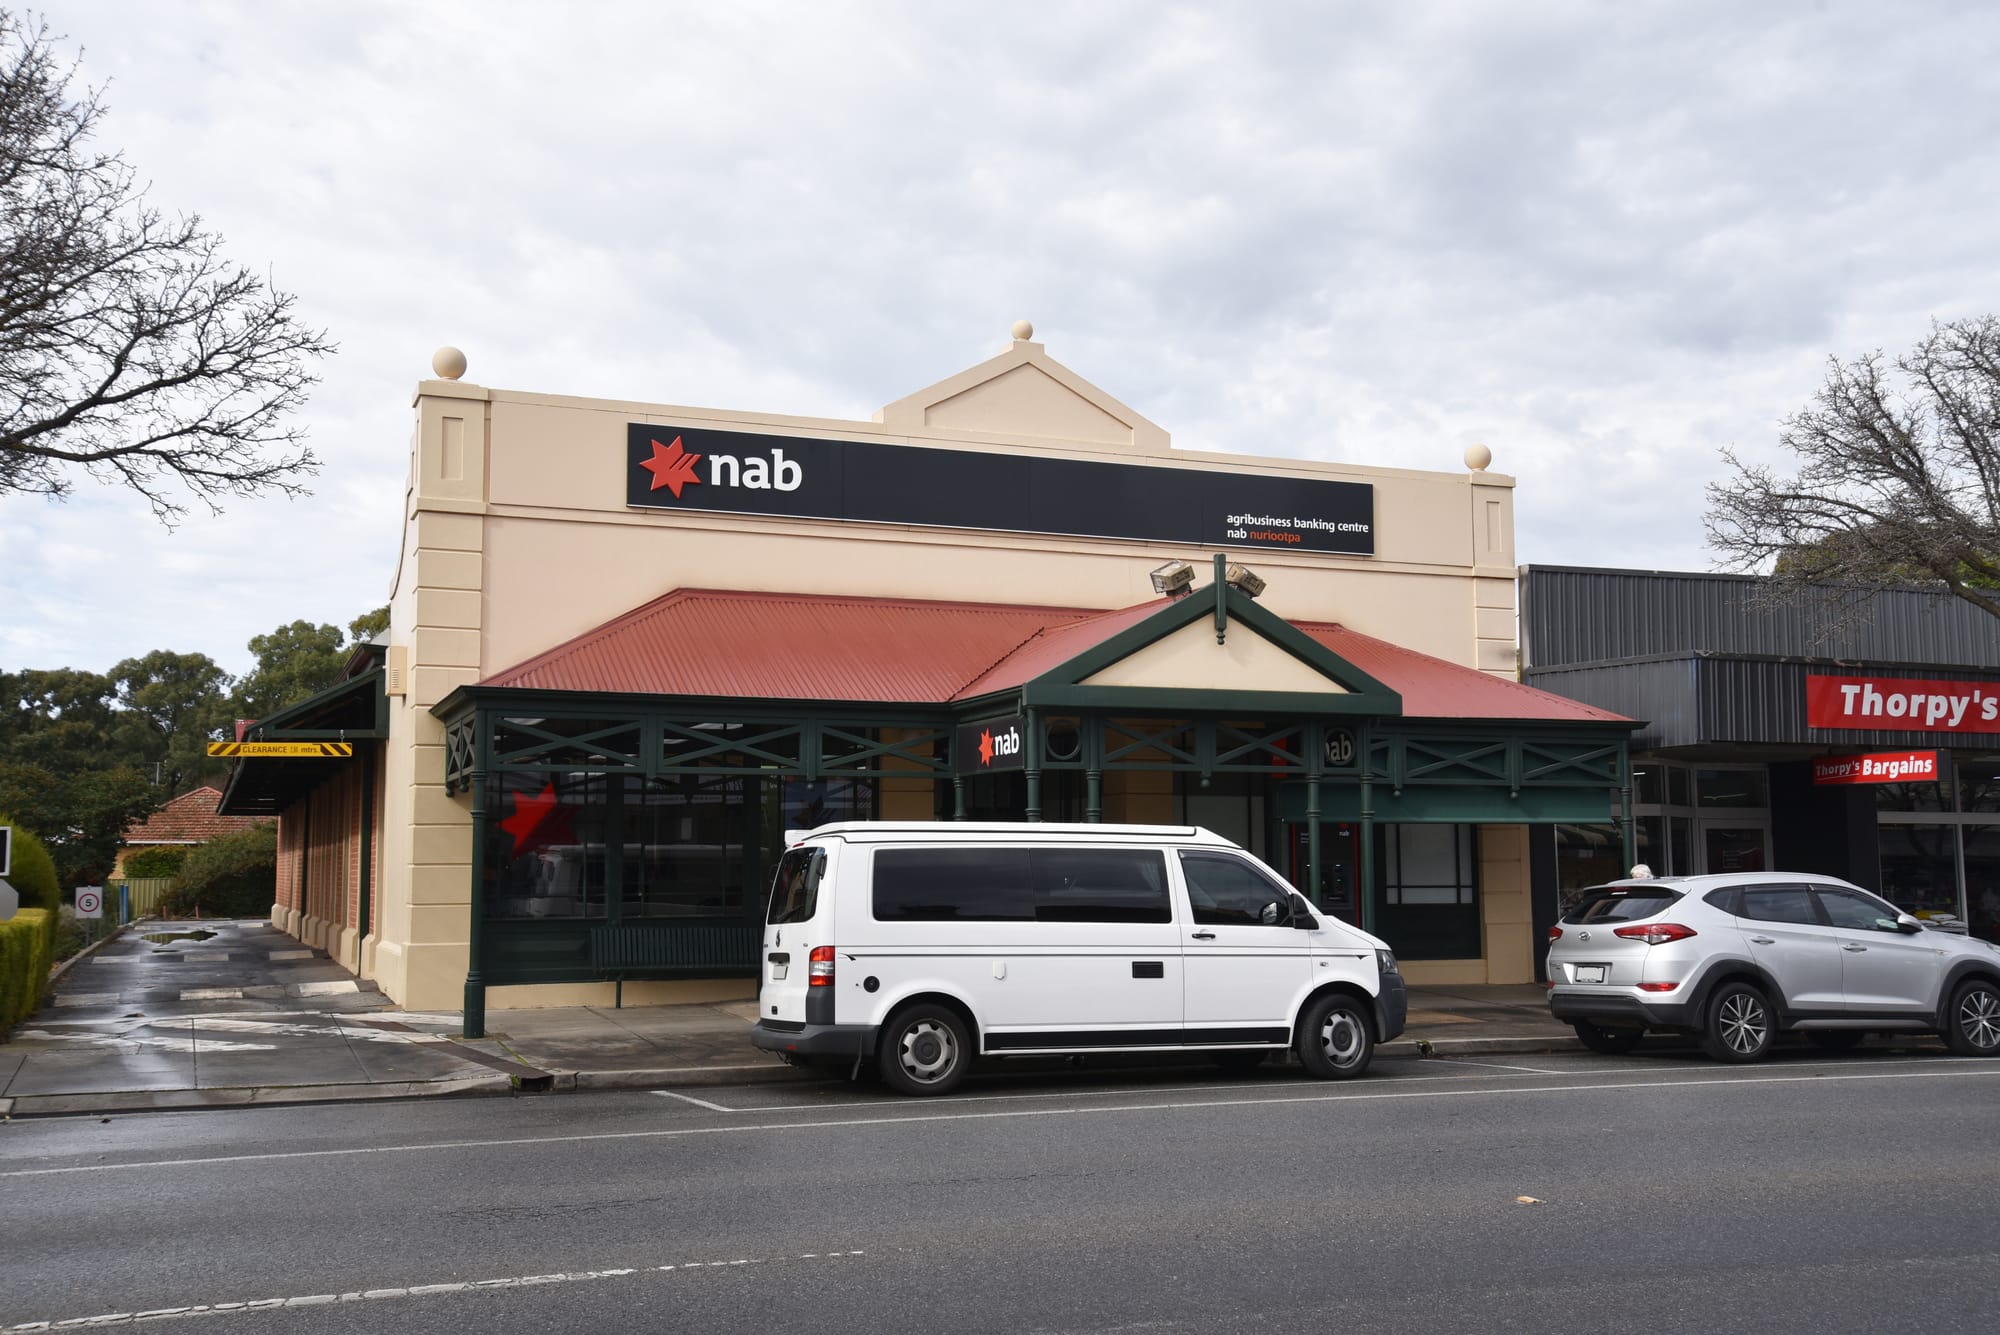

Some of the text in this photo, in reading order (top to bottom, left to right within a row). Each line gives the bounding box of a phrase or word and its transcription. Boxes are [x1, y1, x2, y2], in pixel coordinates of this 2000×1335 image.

[708, 448, 803, 492] nab
[1226, 513, 1369, 533] agribusiness banking centre
[1226, 527, 1301, 544] nab nuriootpa
[1840, 683, 1999, 727] Thorpy's
[242, 745, 288, 753] CLEARANCE
[994, 726, 1020, 756] nab
[1816, 755, 1933, 779] Thorpy's Bargains
[85, 898, 93, 907] 5
